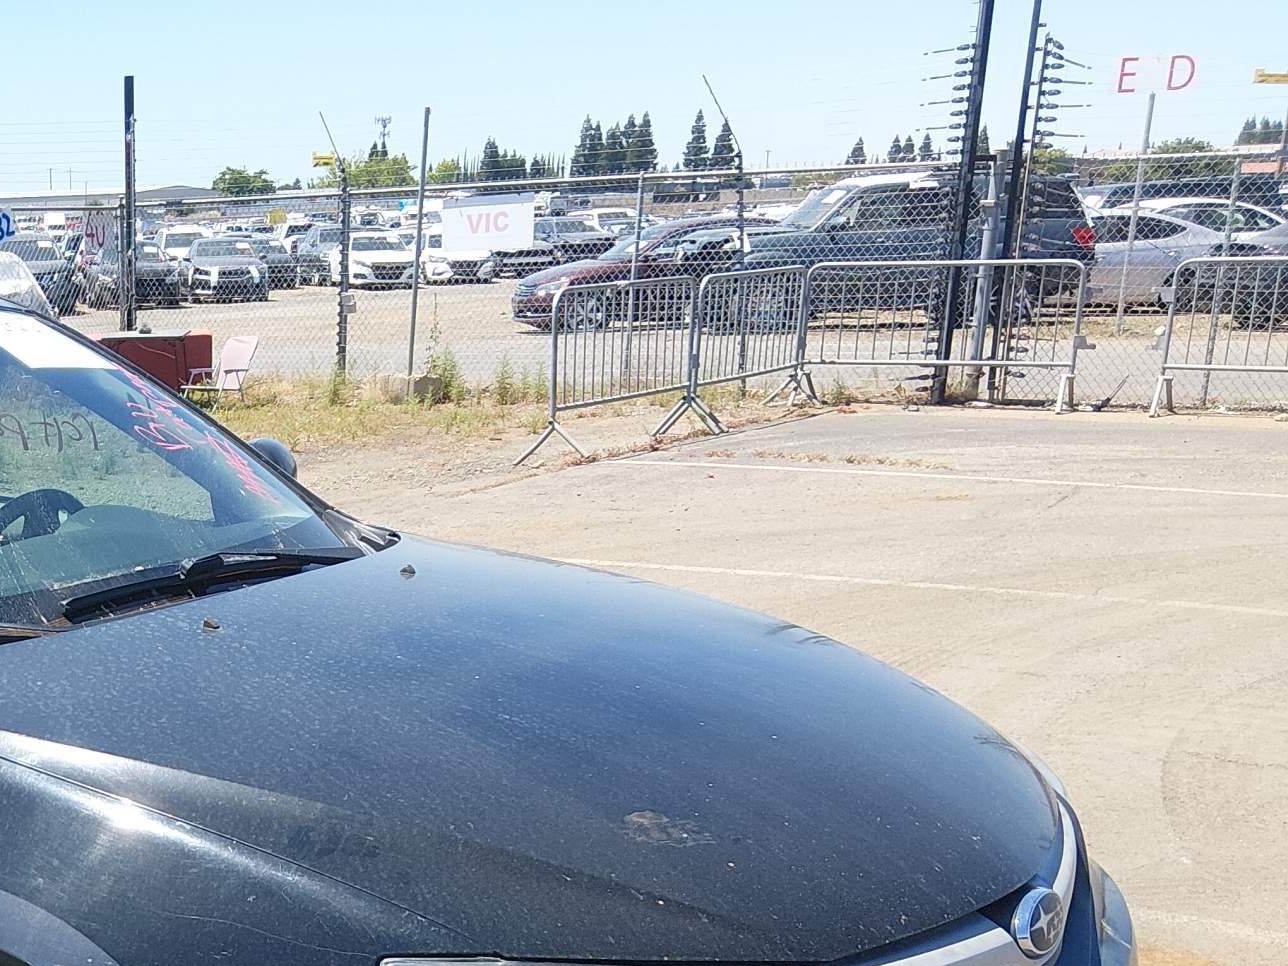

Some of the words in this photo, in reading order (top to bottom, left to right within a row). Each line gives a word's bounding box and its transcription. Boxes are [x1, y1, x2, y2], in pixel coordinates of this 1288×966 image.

[1117, 57, 1139, 93] E
[1166, 54, 1196, 91] D
[466, 211, 509, 234] VIC
